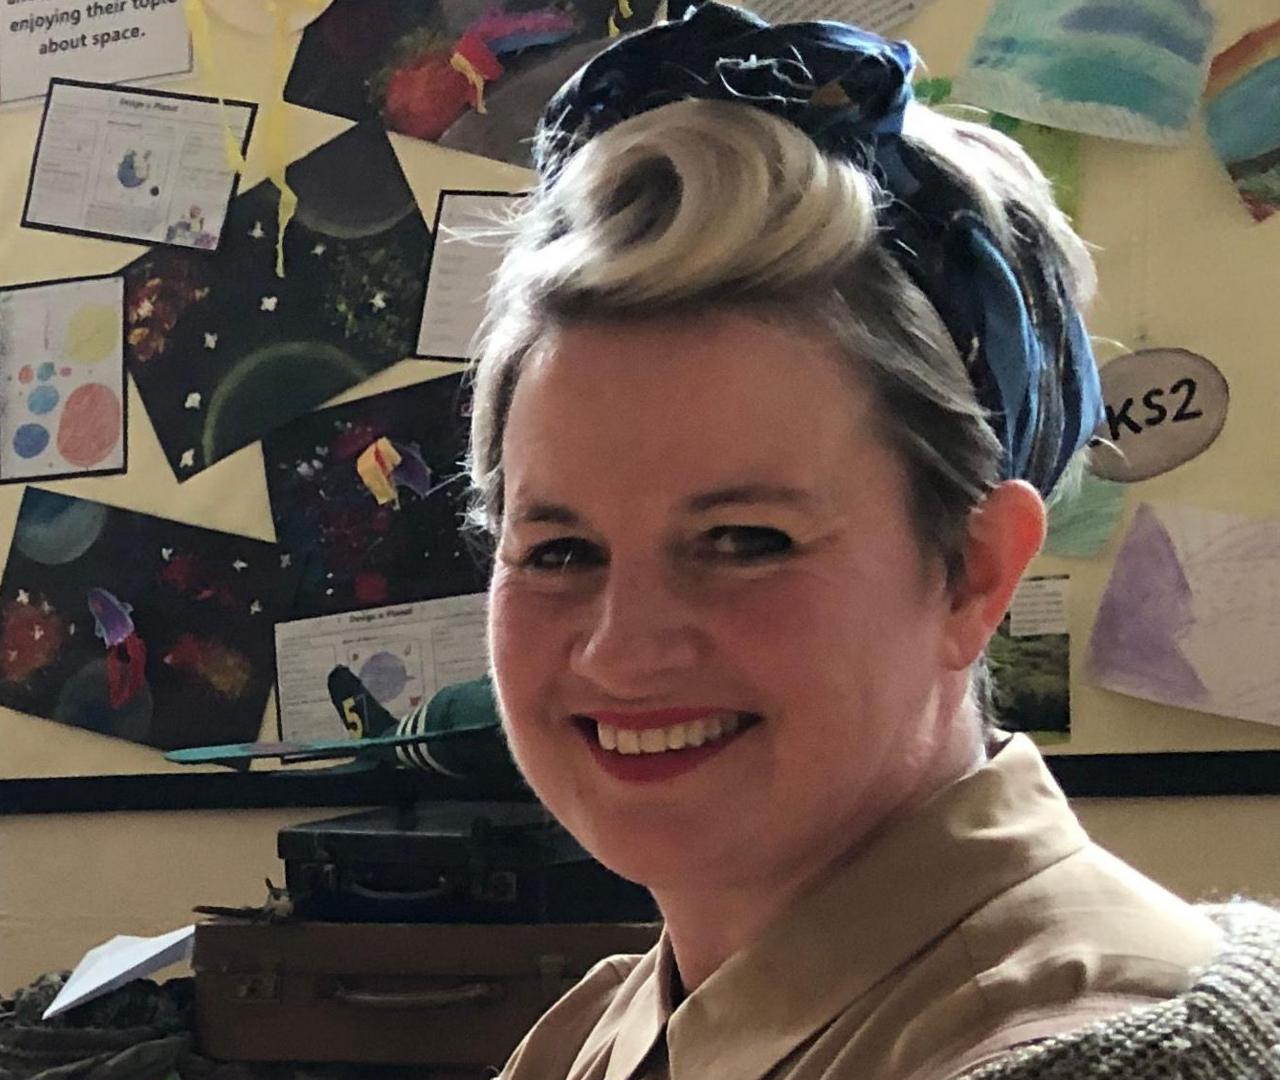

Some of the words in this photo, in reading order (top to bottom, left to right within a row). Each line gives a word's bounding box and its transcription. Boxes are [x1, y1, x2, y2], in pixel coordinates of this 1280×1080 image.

[9, 8, 82, 34] enjoying
[86, 0, 128, 19] their
[38, 33, 88, 56] about
[91, 26, 146, 49] space.
[1105, 378, 1203, 441] KS2
